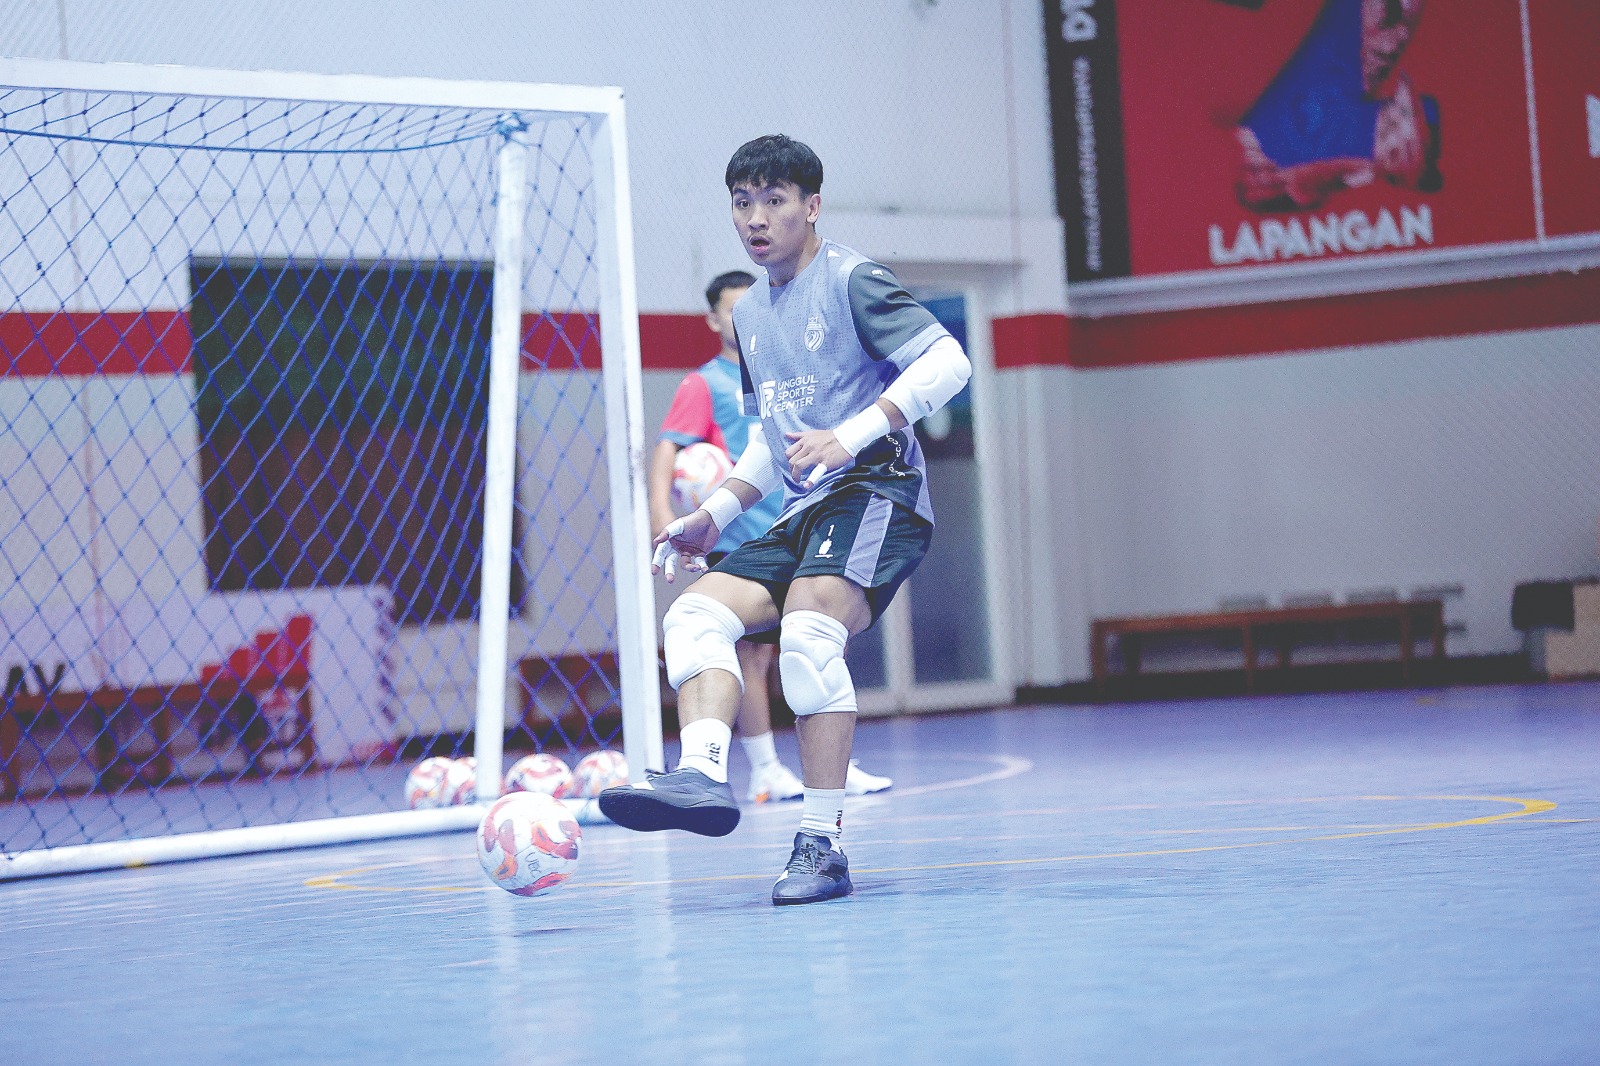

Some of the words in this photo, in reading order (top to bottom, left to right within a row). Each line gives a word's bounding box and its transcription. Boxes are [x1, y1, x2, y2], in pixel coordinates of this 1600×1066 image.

[1208, 204, 1433, 265] LAPANGAN
[777, 375, 819, 391] UNGGUL
[777, 386, 816, 403] SPORTS
[774, 397, 814, 413] CENTER
